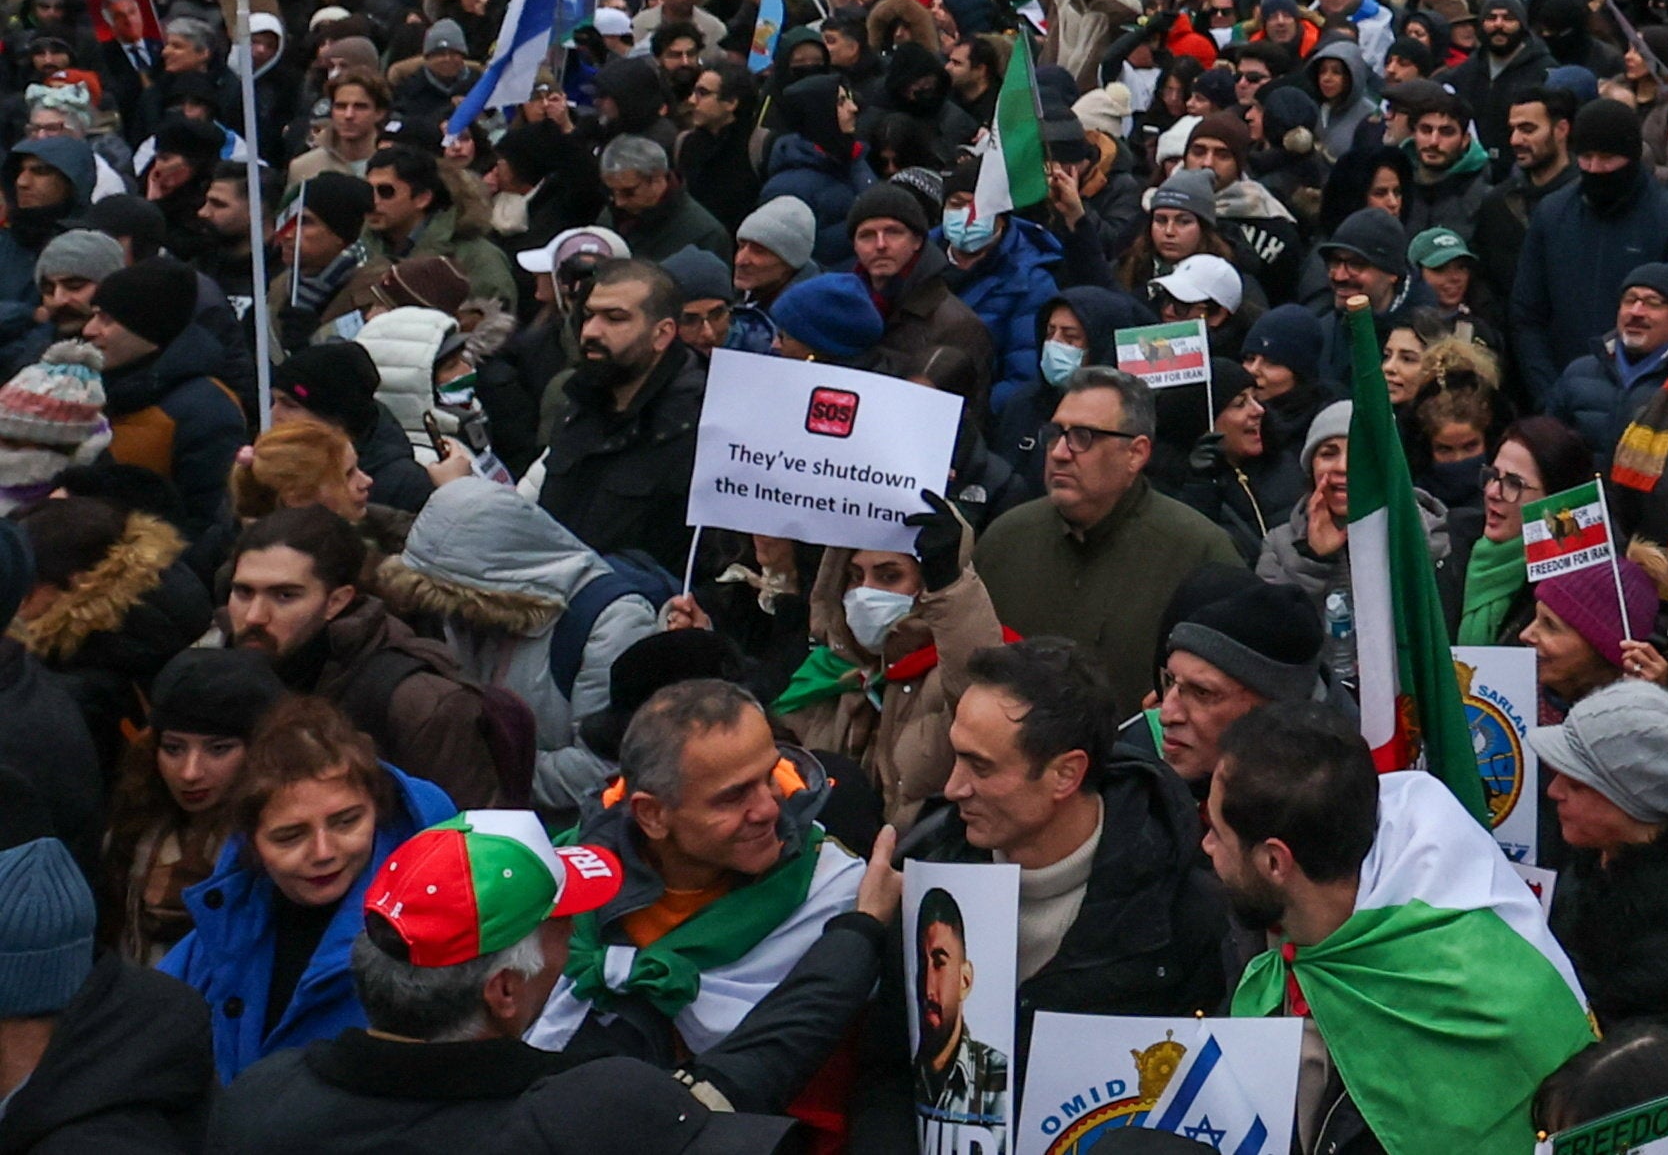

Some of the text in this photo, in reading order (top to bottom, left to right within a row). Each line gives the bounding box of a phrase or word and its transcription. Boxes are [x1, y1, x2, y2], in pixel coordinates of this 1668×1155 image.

[812, 402, 851, 422] SOS
[728, 443, 916, 490] They’ve shutdown
[715, 477, 906, 523] the Internet in Iran
[1530, 545, 1610, 577] FREEDOM FOR IRAN
[557, 846, 613, 879] IRA
[1040, 1079, 1127, 1136] OMID
